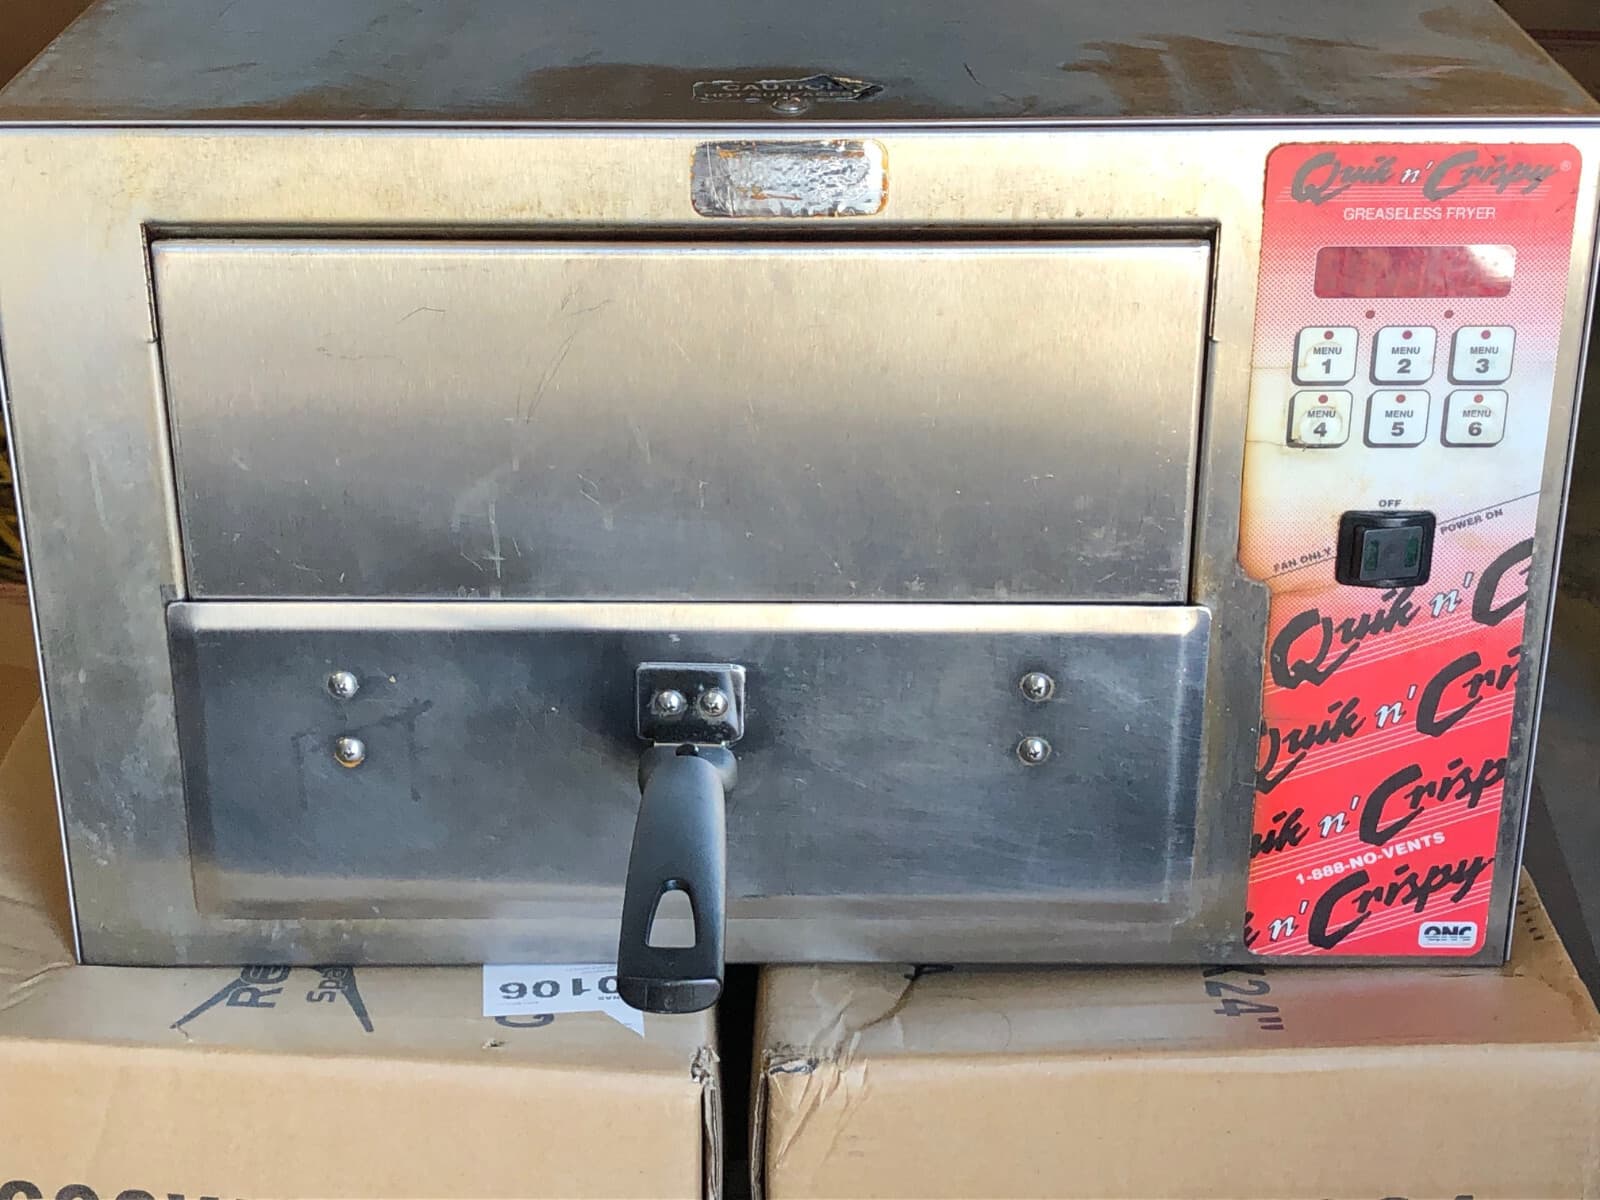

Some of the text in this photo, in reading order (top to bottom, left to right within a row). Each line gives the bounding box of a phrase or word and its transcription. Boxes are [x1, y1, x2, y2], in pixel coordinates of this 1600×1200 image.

[1291, 152, 1397, 205] Quik
[1422, 151, 1560, 202] Crispy
[1343, 206, 1497, 221] GREASELESS FRYER
[1313, 346, 1343, 356] MENU
[1391, 346, 1421, 356] MENU
[1470, 346, 1499, 356] MENU
[1321, 358, 1332, 374] 1
[1397, 358, 1412, 374] 2
[1475, 358, 1490, 374] 3
[1307, 409, 1336, 419] MENU
[1385, 409, 1414, 419] MENU
[1462, 409, 1492, 419] MENU
[1313, 421, 1328, 437] 4
[1391, 421, 1405, 437] 5
[1468, 421, 1483, 437] 6
[1378, 499, 1402, 508] OFF
[1440, 508, 1504, 536] POWER ON
[1273, 547, 1332, 573] FAN ONLY
[1270, 587, 1422, 690] Quik
[1296, 832, 1446, 885] 1-888-NO-VENTS
[1308, 856, 1497, 950] Crispy
